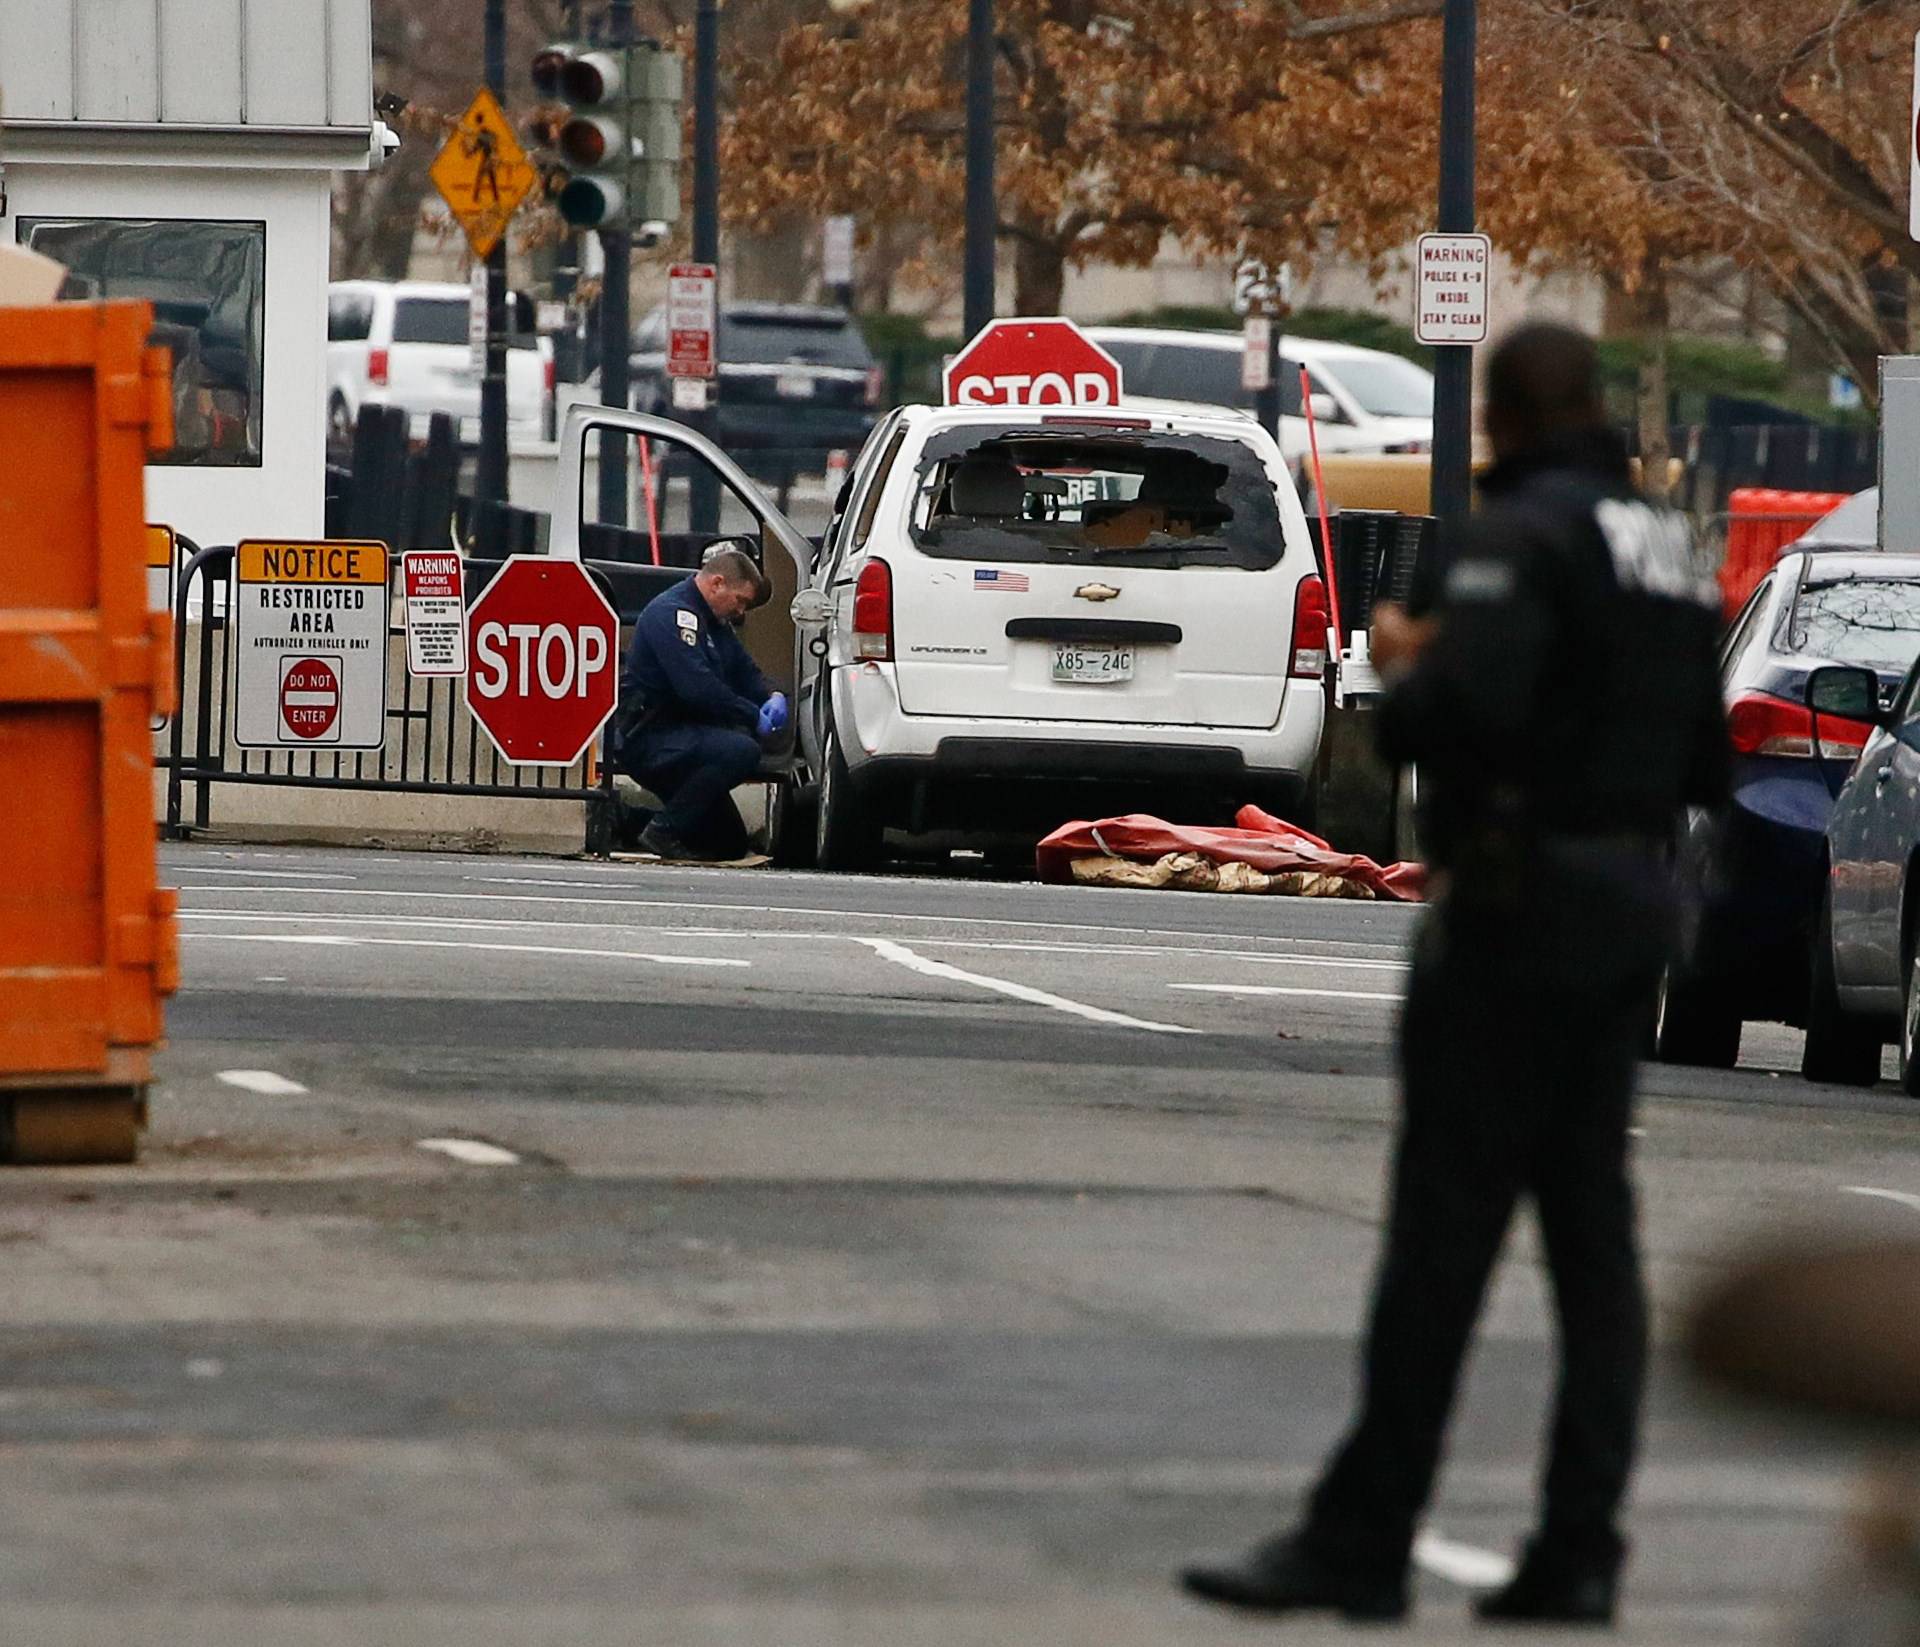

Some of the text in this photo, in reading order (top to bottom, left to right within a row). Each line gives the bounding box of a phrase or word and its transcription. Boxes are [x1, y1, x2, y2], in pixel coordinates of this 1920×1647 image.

[1423, 247, 1484, 263] WARNING
[1424, 271, 1457, 282] POLICE
[1435, 292, 1470, 303] INSIDE
[1423, 313, 1482, 325] STAY CLEAR
[263, 547, 361, 579] NOTICE
[407, 558, 457, 575] WARNING
[260, 588, 364, 609] RESTRICTED
[290, 612, 334, 633] AREA
[254, 637, 370, 650] AUTHORIZED VEHICLES ONLY
[474, 621, 608, 700] STOP
[289, 674, 331, 687] DO NOT
[292, 710, 326, 723] ENTER
